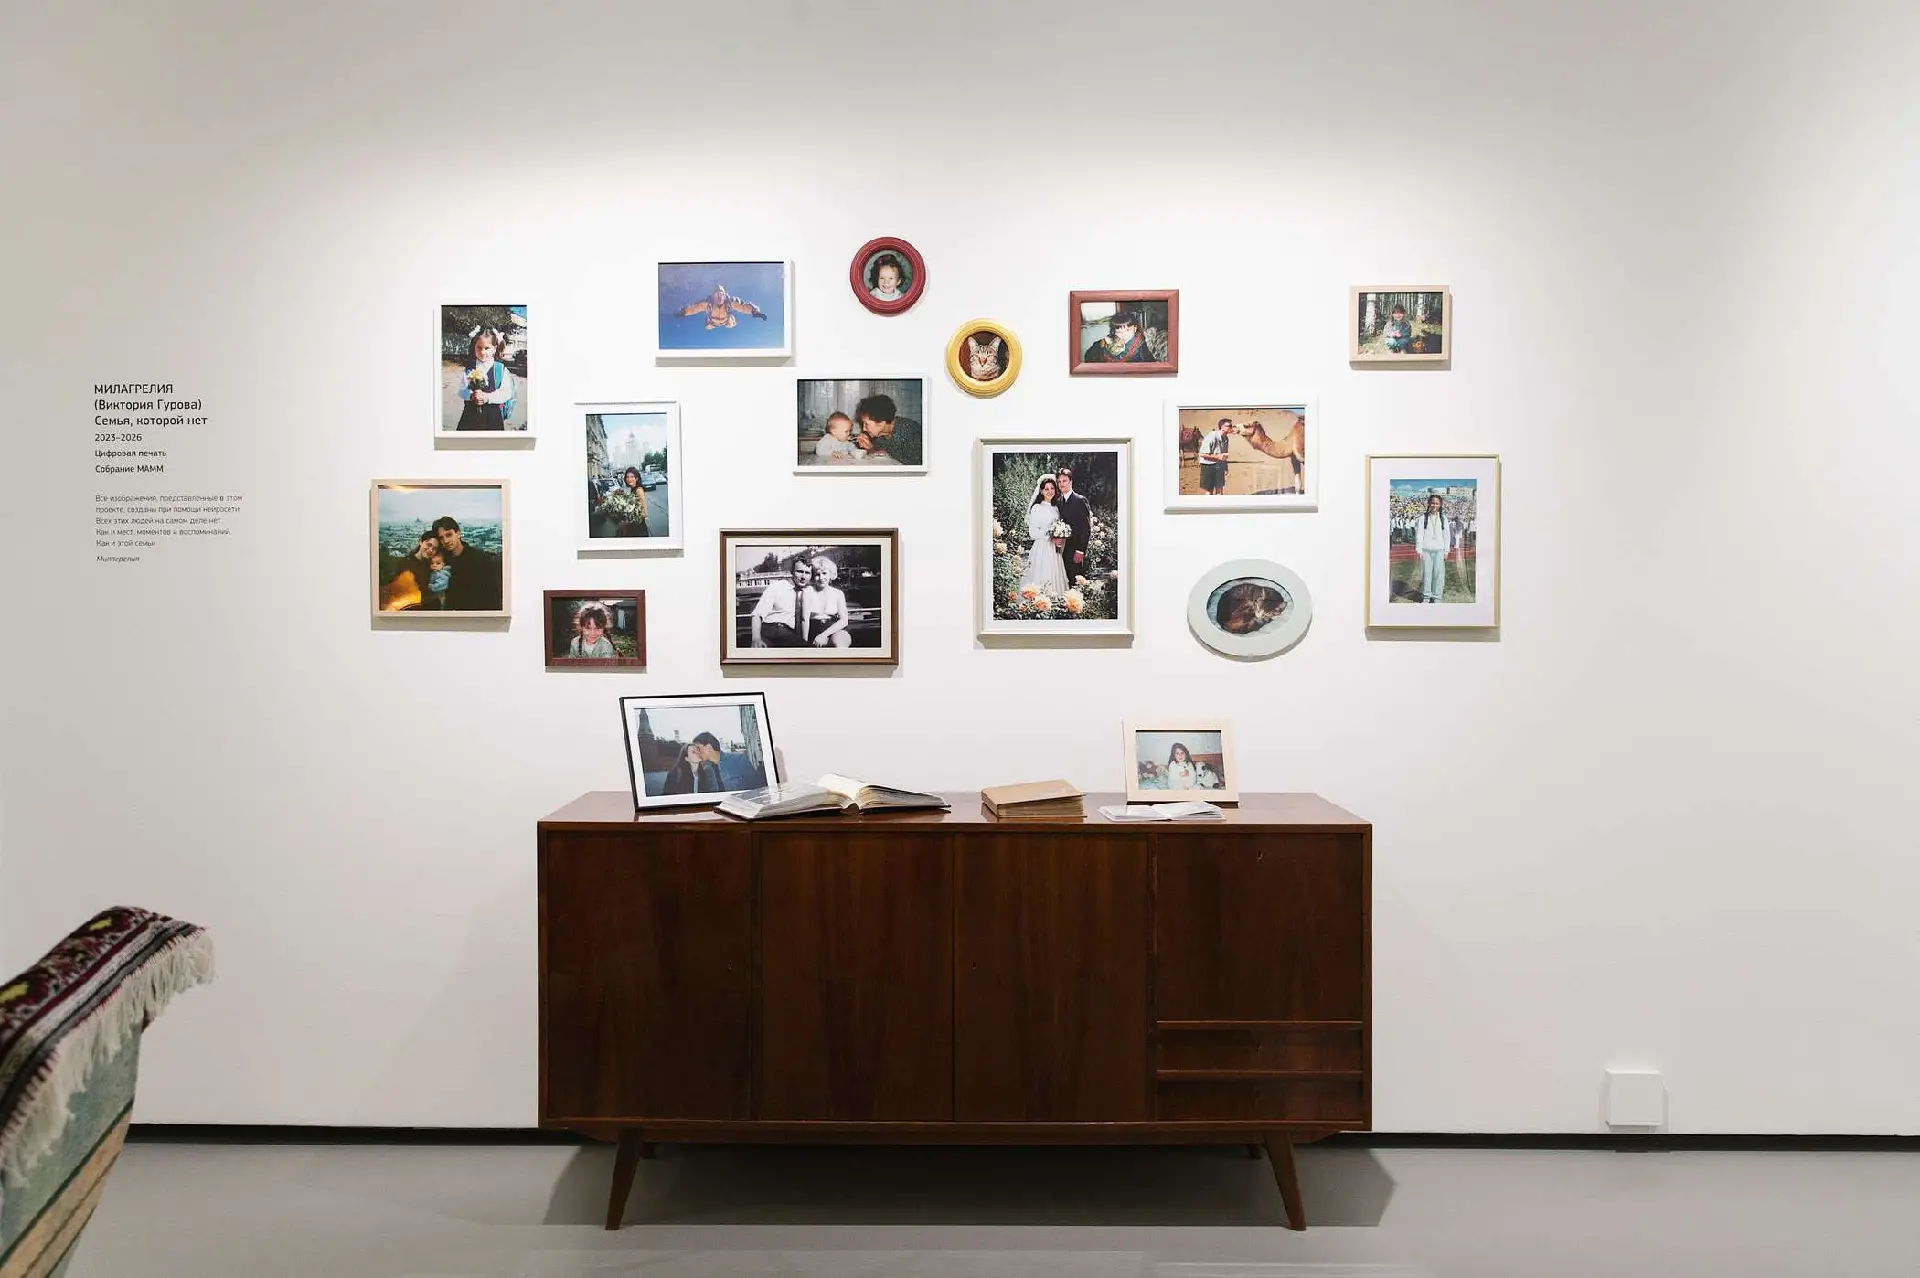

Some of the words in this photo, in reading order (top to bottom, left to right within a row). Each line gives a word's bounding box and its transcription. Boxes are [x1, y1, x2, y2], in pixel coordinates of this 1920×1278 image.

[94, 383, 174, 394] МИЛАГРЕЛИЯ
[94, 399, 154, 411] (Виктория
[157, 399, 202, 411] Гурова)
[94, 415, 134, 428] Семья,
[136, 415, 184, 427] которой
[187, 417, 208, 425] нет
[94, 450, 136, 458] Цифровая
[95, 464, 135, 474] Собрание
[137, 464, 164, 473] МАММ
